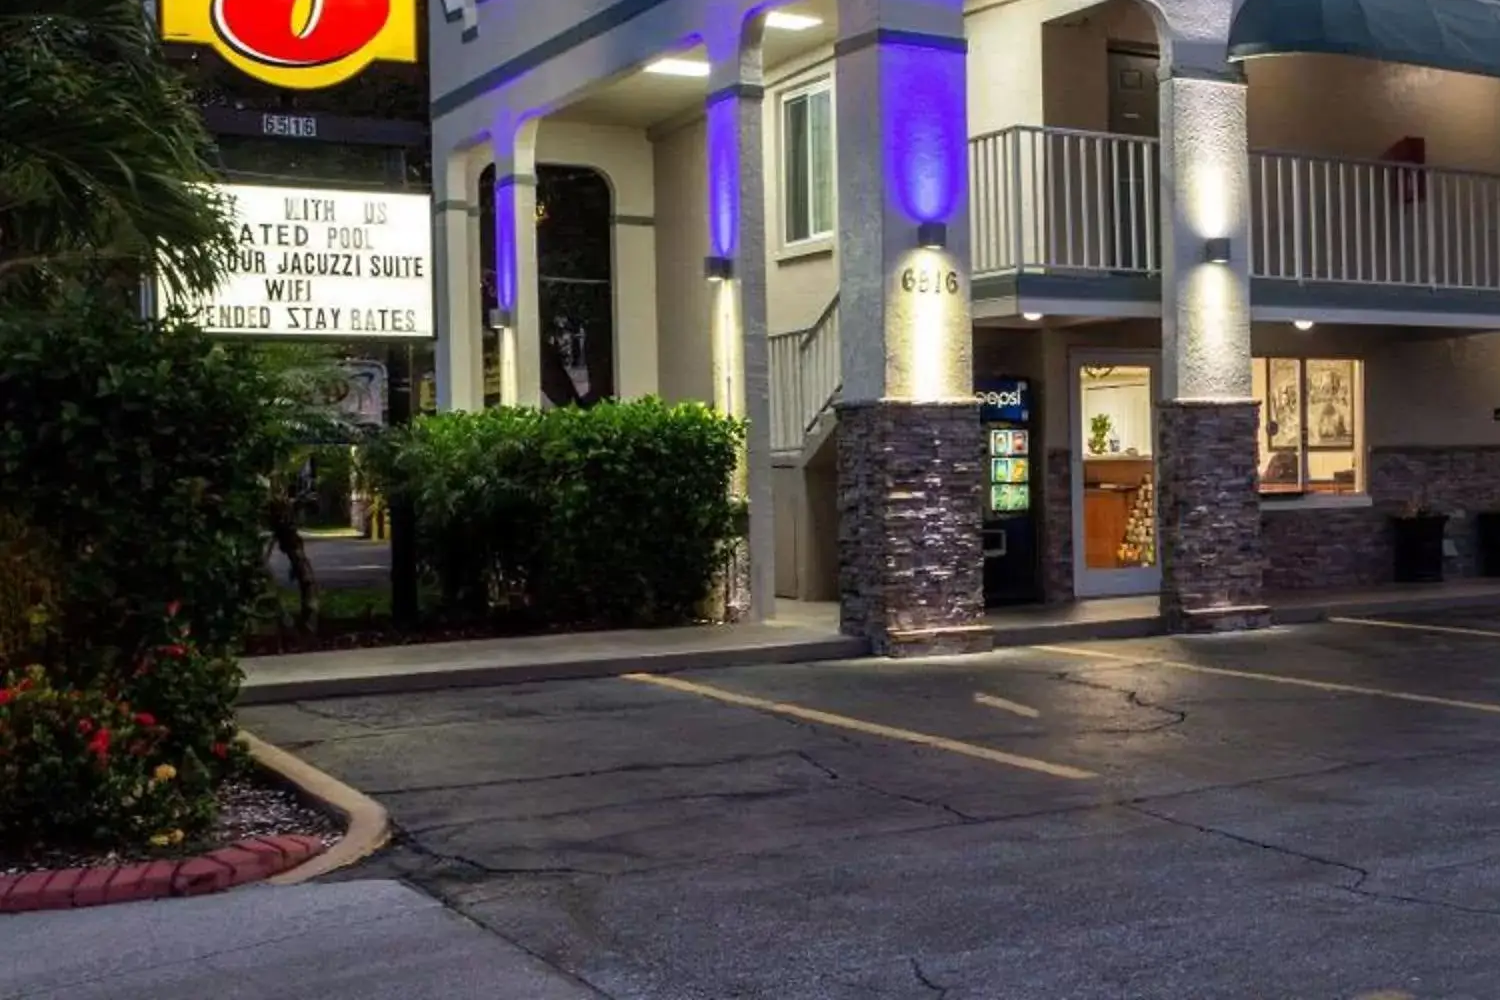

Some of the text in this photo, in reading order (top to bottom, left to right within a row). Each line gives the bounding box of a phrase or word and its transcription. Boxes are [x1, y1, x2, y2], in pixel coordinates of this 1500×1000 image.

[284, 197, 388, 225] WITH US
[238, 223, 375, 250] ATED POOL
[277, 251, 361, 277] JACUZZI
[369, 255, 424, 278] SUITE
[264, 279, 312, 302] WIFI
[204, 303, 272, 329] ENDED
[287, 306, 341, 330] STAY
